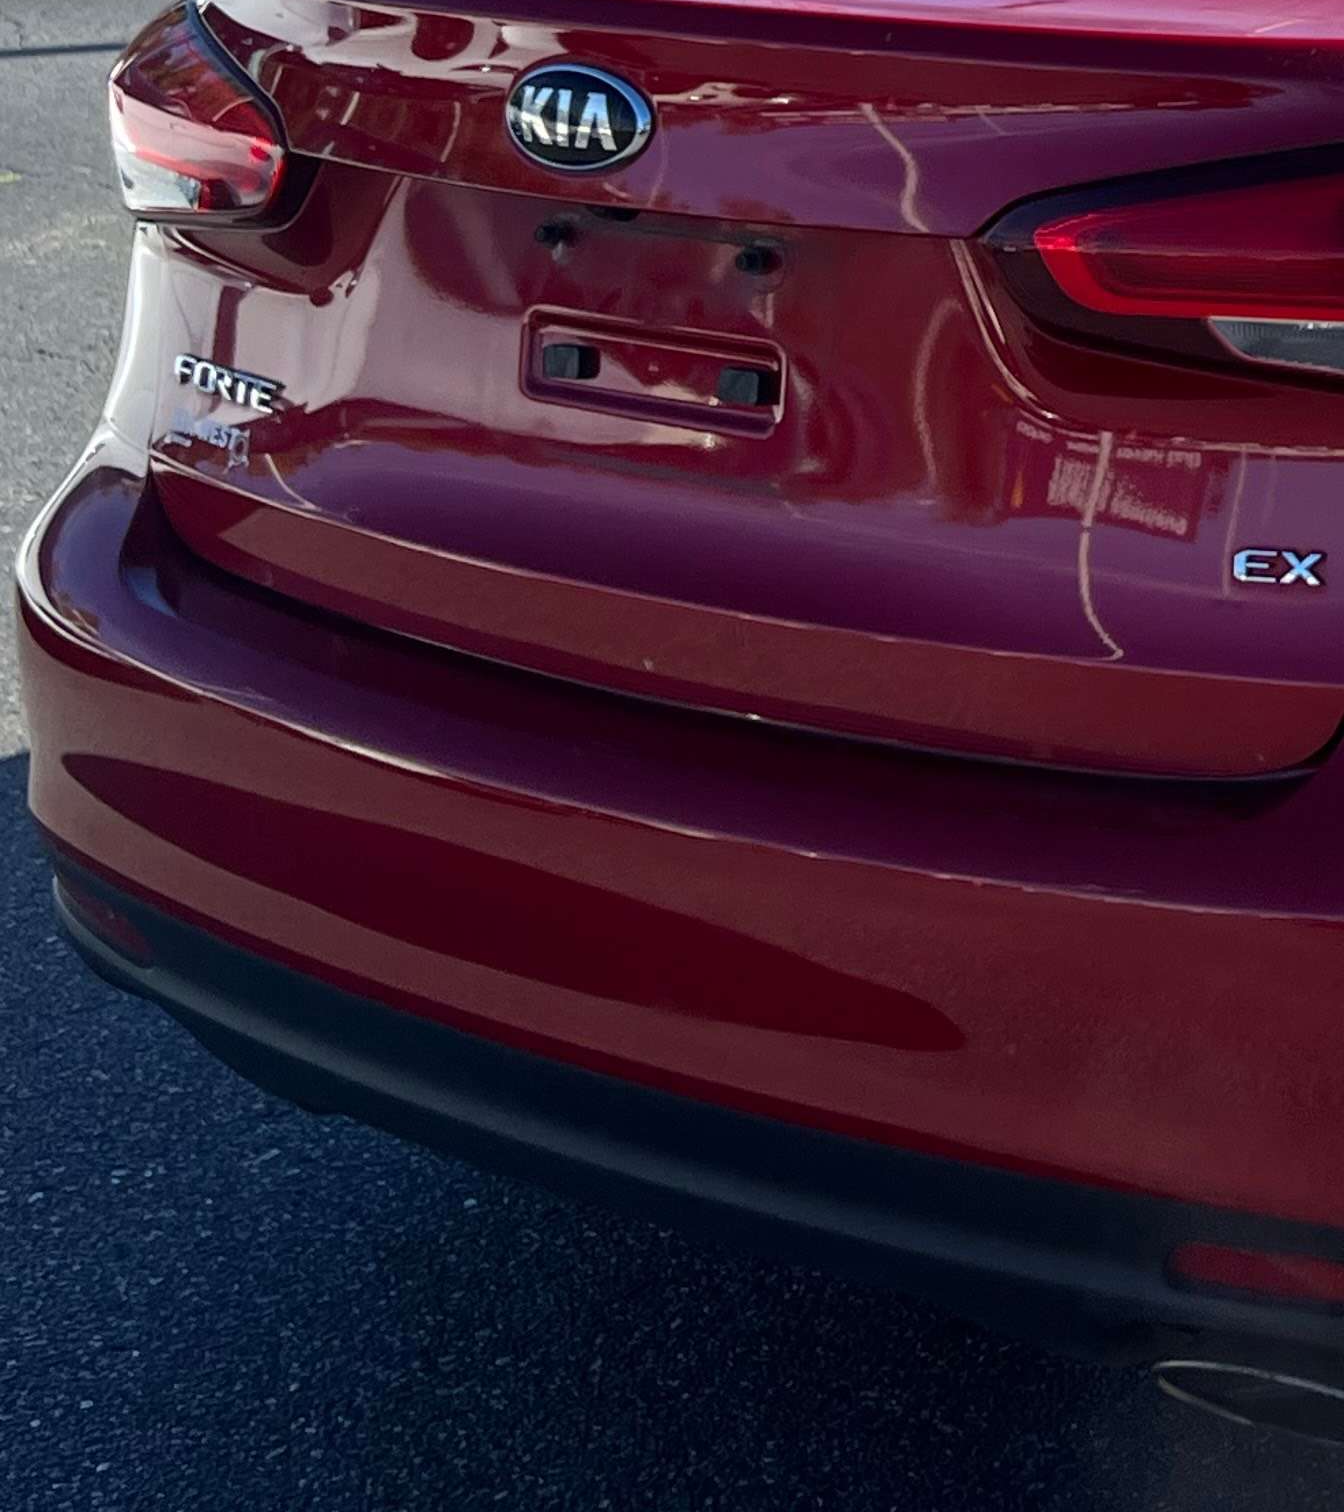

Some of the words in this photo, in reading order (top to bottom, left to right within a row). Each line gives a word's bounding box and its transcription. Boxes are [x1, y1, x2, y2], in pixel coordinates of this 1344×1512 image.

[520, 84, 618, 152] KIA
[173, 352, 280, 415] FORTE
[1232, 548, 1323, 587] EX
